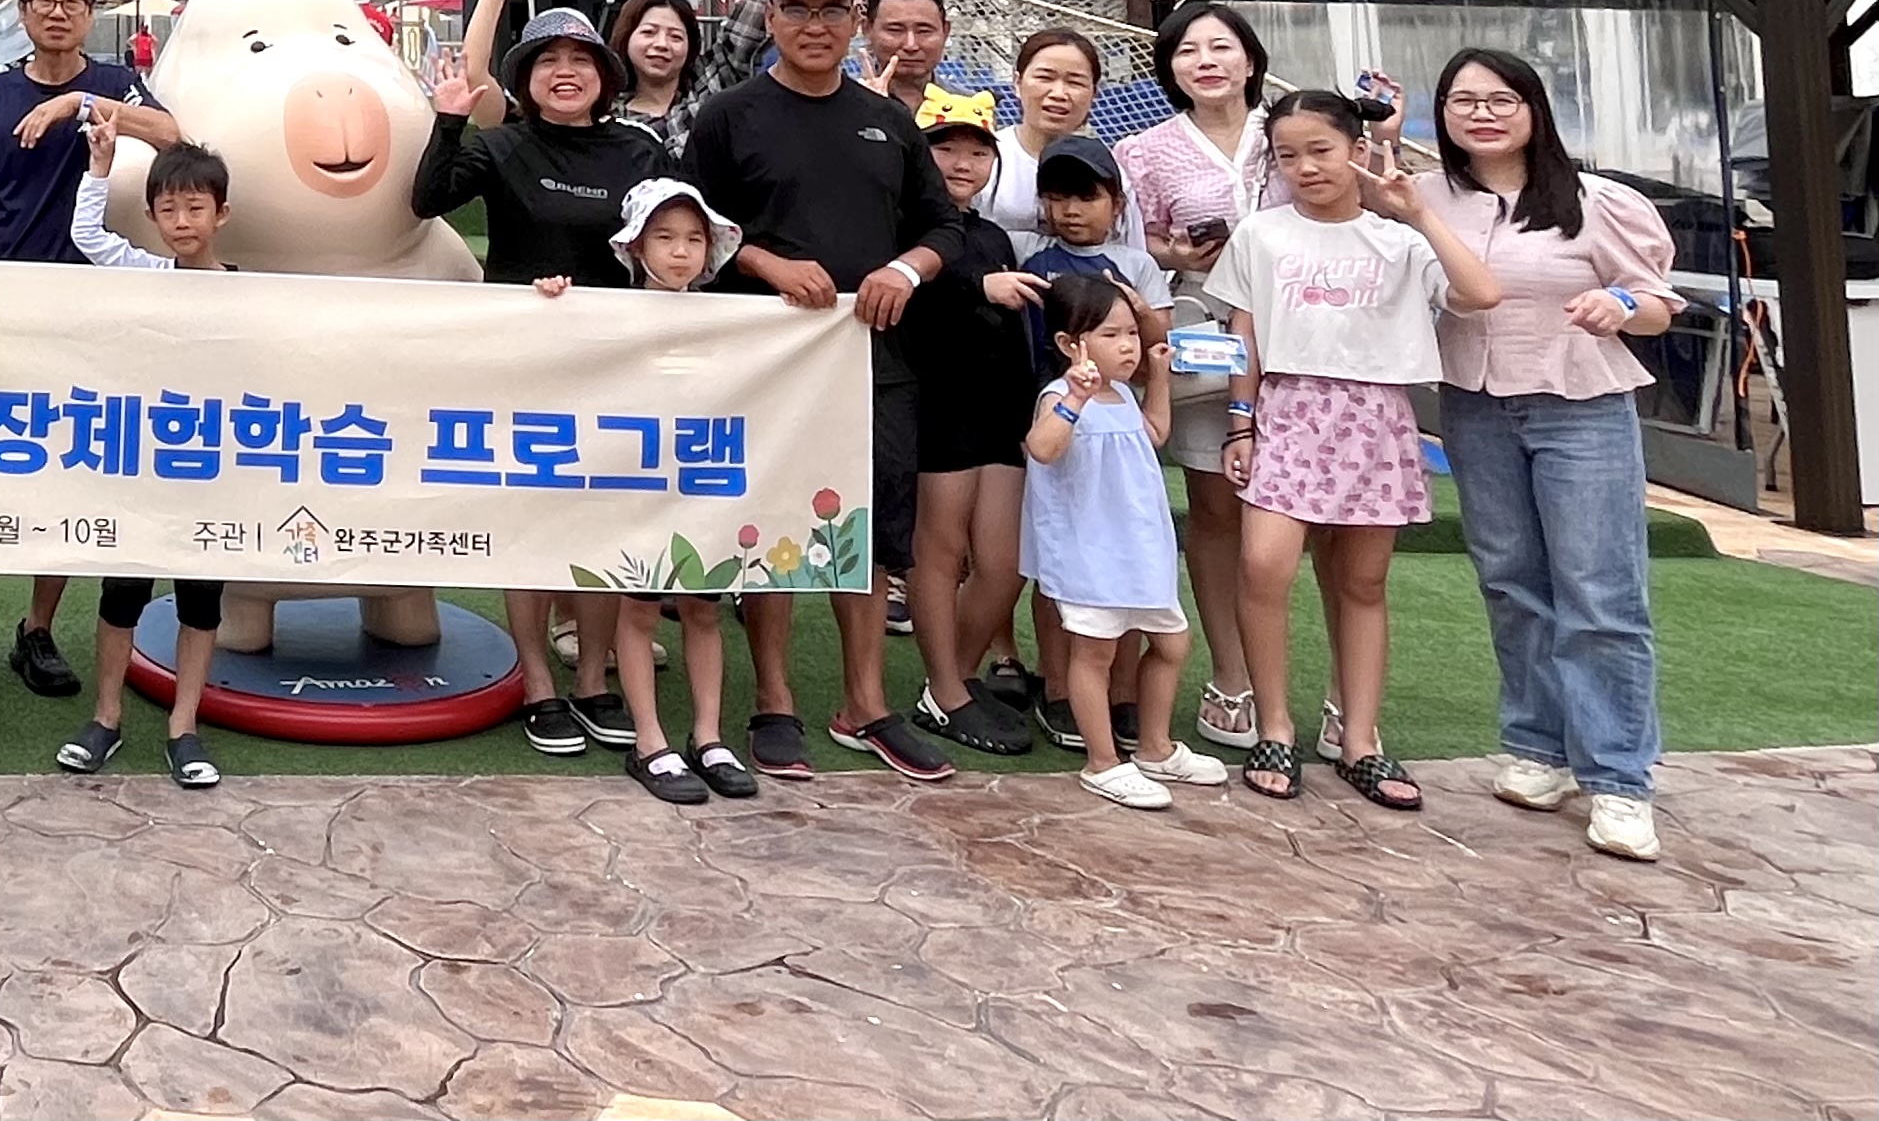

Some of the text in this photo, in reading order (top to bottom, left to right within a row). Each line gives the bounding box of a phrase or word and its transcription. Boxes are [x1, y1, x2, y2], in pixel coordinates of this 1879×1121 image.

[420, 409, 748, 498] 프로그램
[60, 518, 118, 548] 10월
[193, 521, 246, 552] 주관
[285, 522, 316, 546] 가족
[333, 527, 492, 557] 완주군가족센터
[280, 676, 450, 695] Amazn
